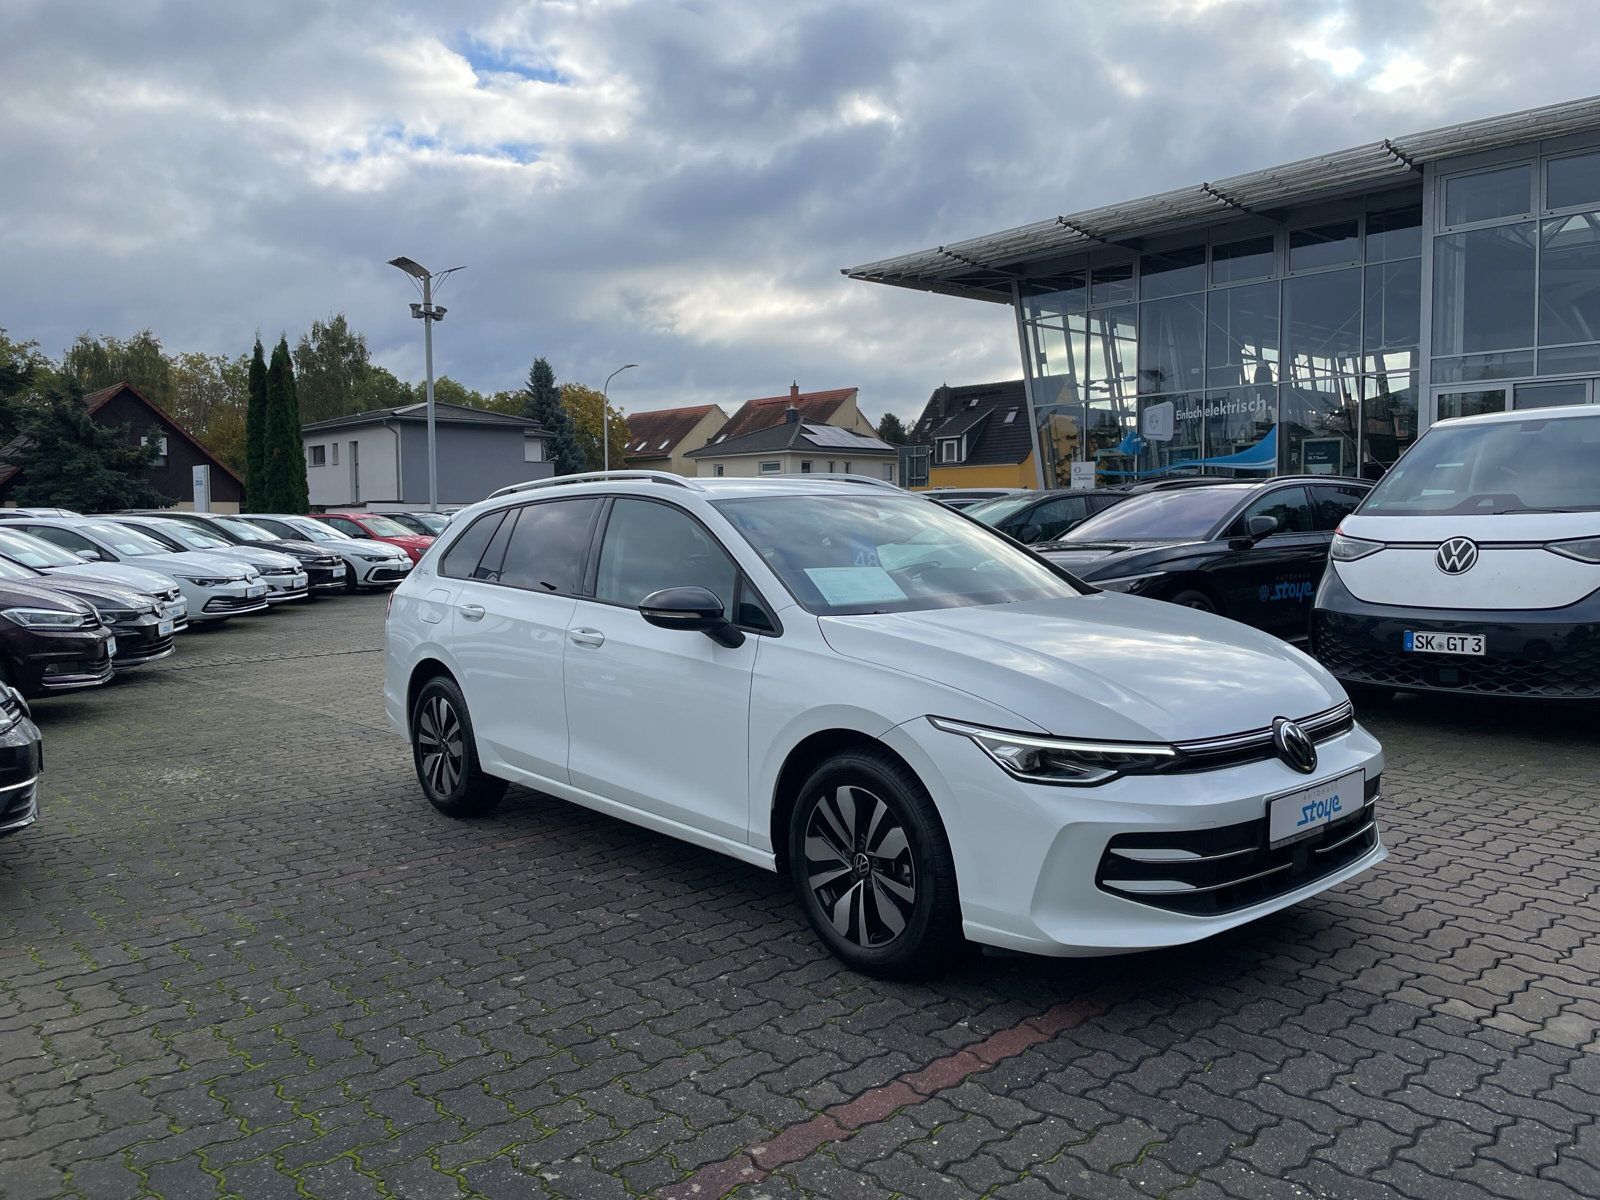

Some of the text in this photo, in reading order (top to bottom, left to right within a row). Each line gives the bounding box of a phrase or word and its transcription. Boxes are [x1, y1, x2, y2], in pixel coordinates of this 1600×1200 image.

[1176, 393, 1273, 421] Einfach elektrisch.
[1414, 634, 1436, 651] SK
[1446, 636, 1469, 652] GT
[1471, 637, 1482, 653] 3
